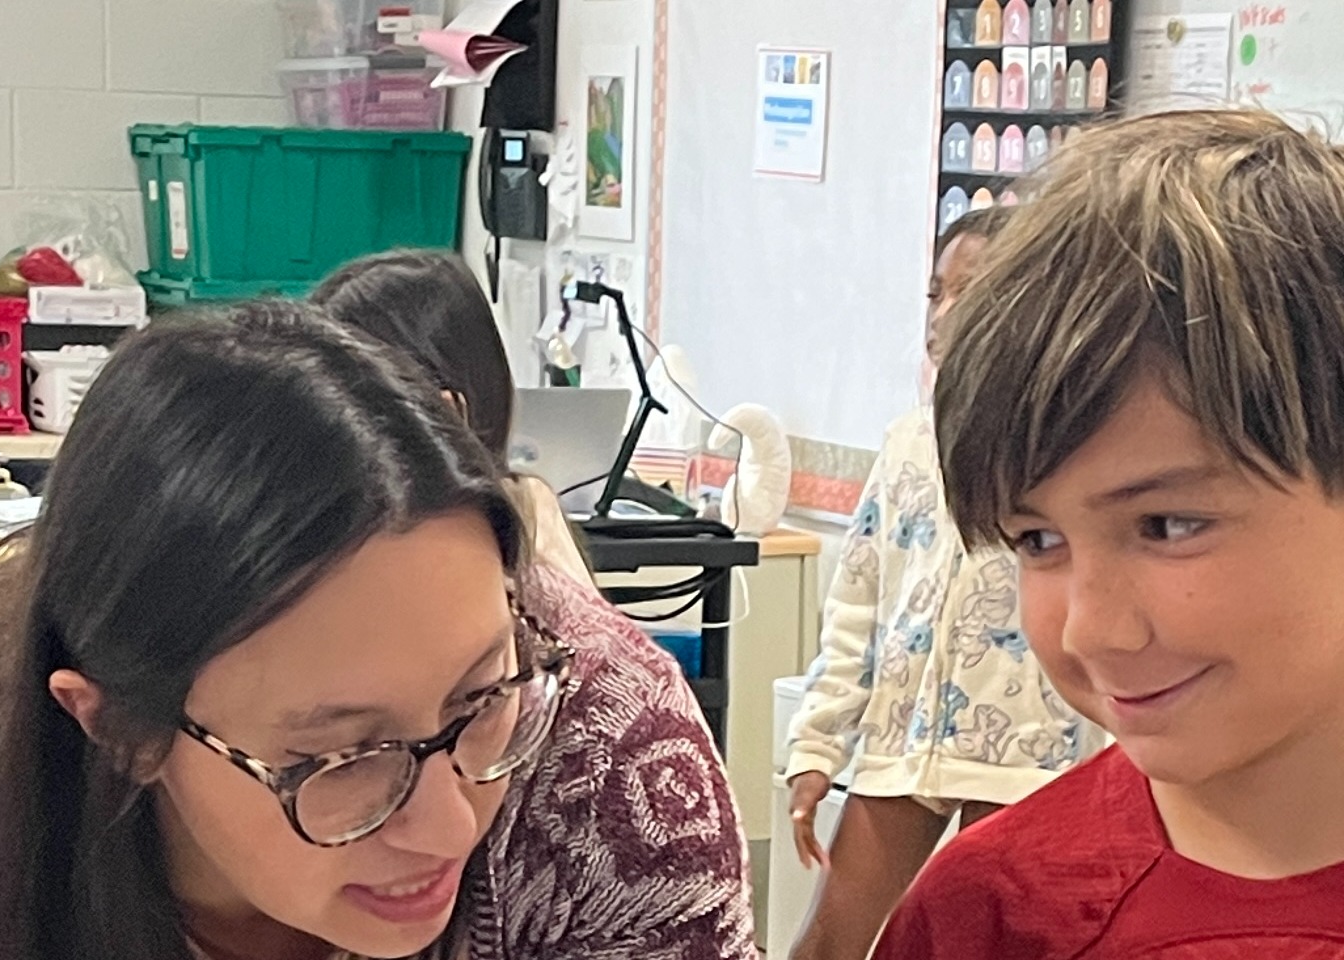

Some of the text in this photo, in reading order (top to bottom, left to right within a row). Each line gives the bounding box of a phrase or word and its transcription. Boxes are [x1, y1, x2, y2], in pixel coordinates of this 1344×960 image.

[1074, 9, 1082, 32] 5
[952, 75, 962, 96] 7
[948, 139, 966, 160] 14
